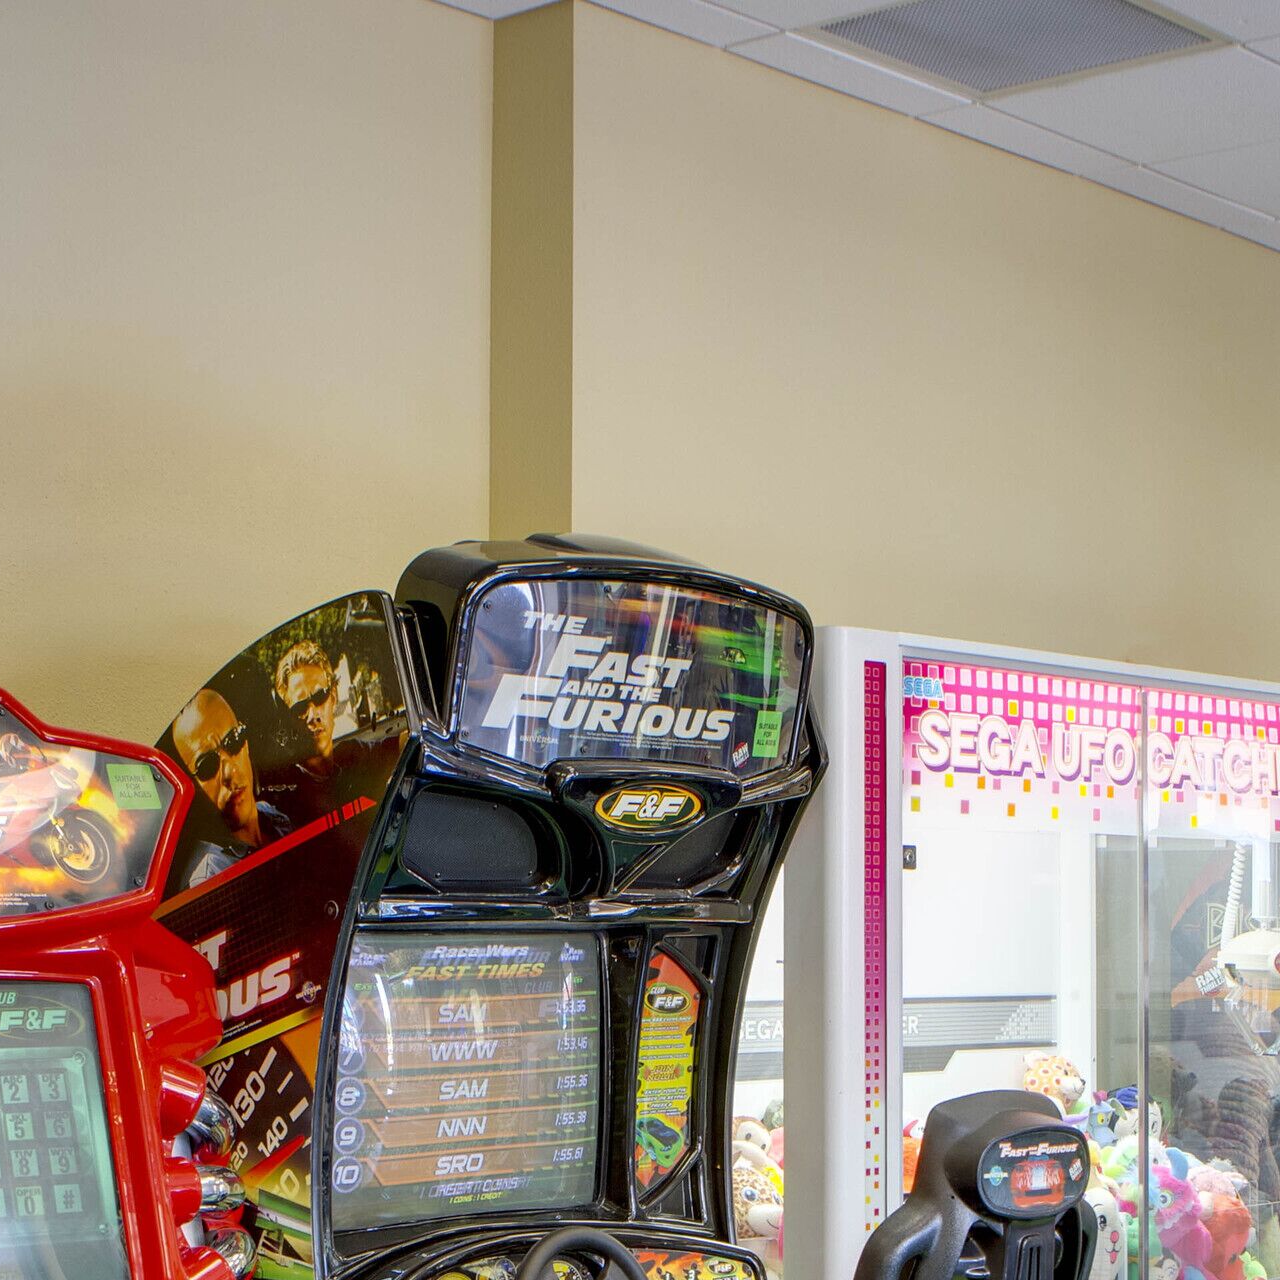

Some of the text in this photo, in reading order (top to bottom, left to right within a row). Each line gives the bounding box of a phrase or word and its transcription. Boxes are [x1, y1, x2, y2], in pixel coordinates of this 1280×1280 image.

[523, 611, 588, 635] THE
[545, 633, 694, 688] FAST
[560, 681, 663, 703] AND THE
[904, 677, 943, 699] SEGA
[481, 673, 735, 741] FURIOUS
[918, 709, 1047, 779] SEGA
[1052, 722, 1136, 786] UFO
[610, 792, 689, 821] F&F
[194, 931, 226, 973] T
[403, 963, 545, 980] FAST TIMES
[654, 996, 683, 1009] F&F
[0, 1009, 67, 1032] F&F
[430, 1040, 498, 1062] WWW
[10, 1084, 21, 1099] 2
[439, 1079, 489, 1100] SAM
[557, 1074, 588, 1089] 1:55.36
[229, 1071, 266, 1129] 130
[340, 1086, 358, 1106] 8
[436, 1116, 487, 1138] NNN
[555, 1111, 587, 1126] 1:55.38
[15, 1124, 26, 1140] 5
[258, 1116, 288, 1157] 140
[340, 1126, 357, 1145] 9
[1000, 1142, 1079, 1158] FAST FURIOUS
[336, 1165, 359, 1185] 10
[435, 1153, 484, 1175] SRO
